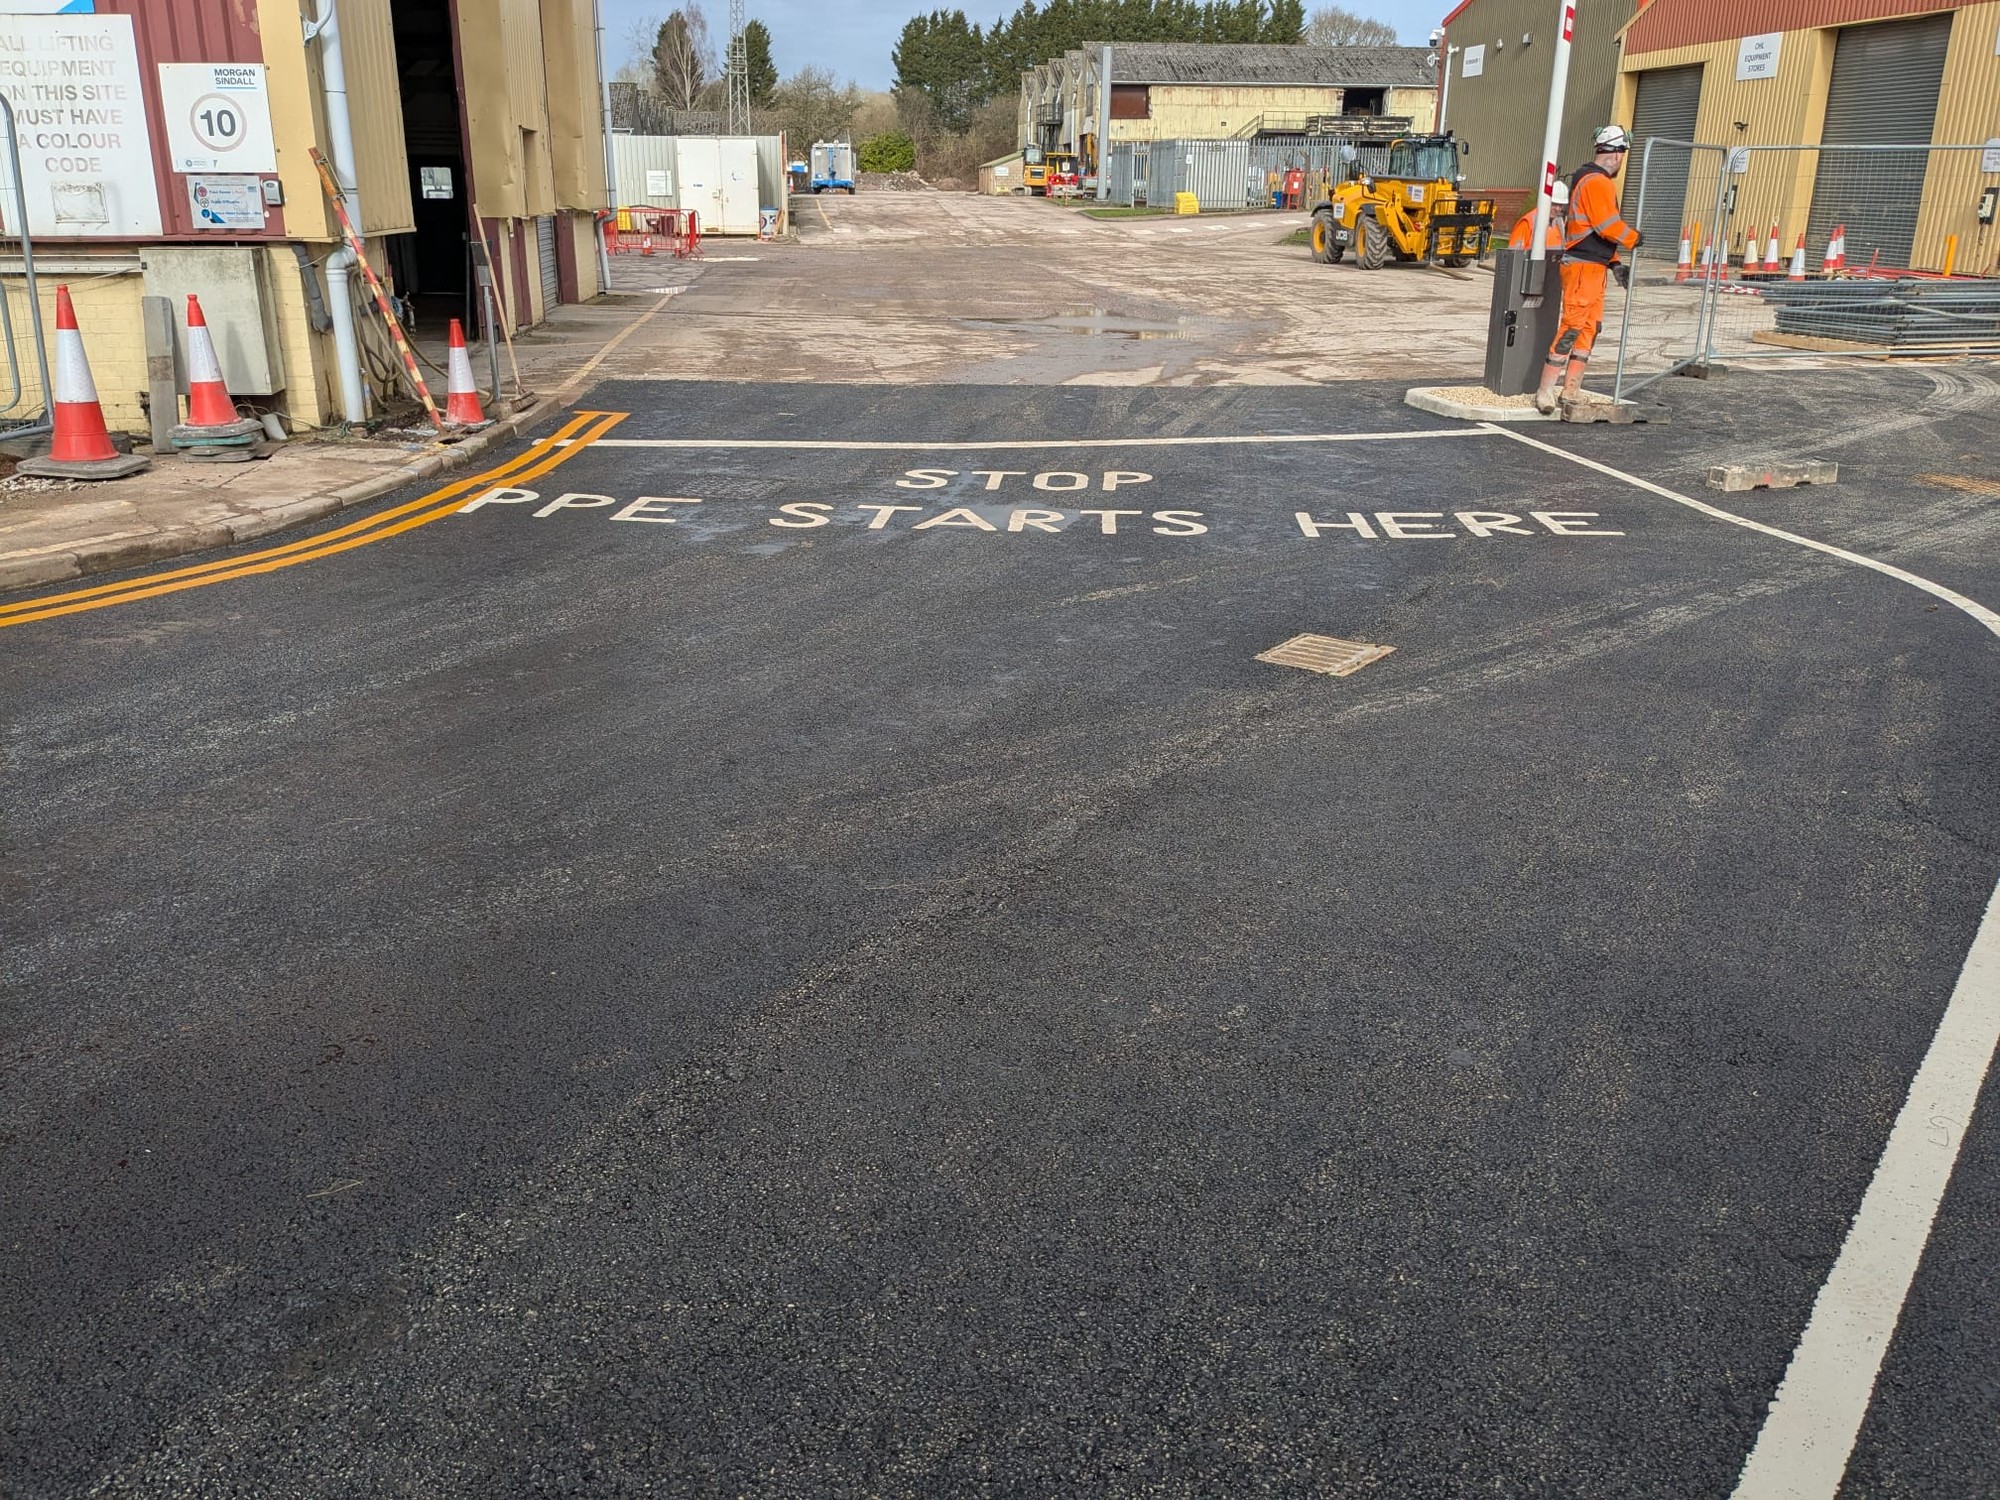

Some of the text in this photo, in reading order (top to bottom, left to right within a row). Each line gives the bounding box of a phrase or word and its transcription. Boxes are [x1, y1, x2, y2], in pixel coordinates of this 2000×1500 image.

[38, 35, 115, 52] LIFTING
[1744, 52, 1772, 62] EQUIPMENT
[0, 60, 117, 77] EQUIPMENT
[214, 68, 256, 77] MORGAN
[1748, 64, 1766, 72] STORES
[215, 77, 254, 86] SINDALL
[31, 84, 78, 101] THIS
[82, 84, 128, 101] SITE
[69, 109, 124, 125] HAVE
[200, 109, 236, 137] 10
[18, 133, 122, 149] A COLOUR
[45, 157, 103, 172] CODE
[1336, 230, 1348, 241] JCB
[894, 468, 1153, 492] STOP
[456, 487, 1626, 539] PPE STARTS HERE
